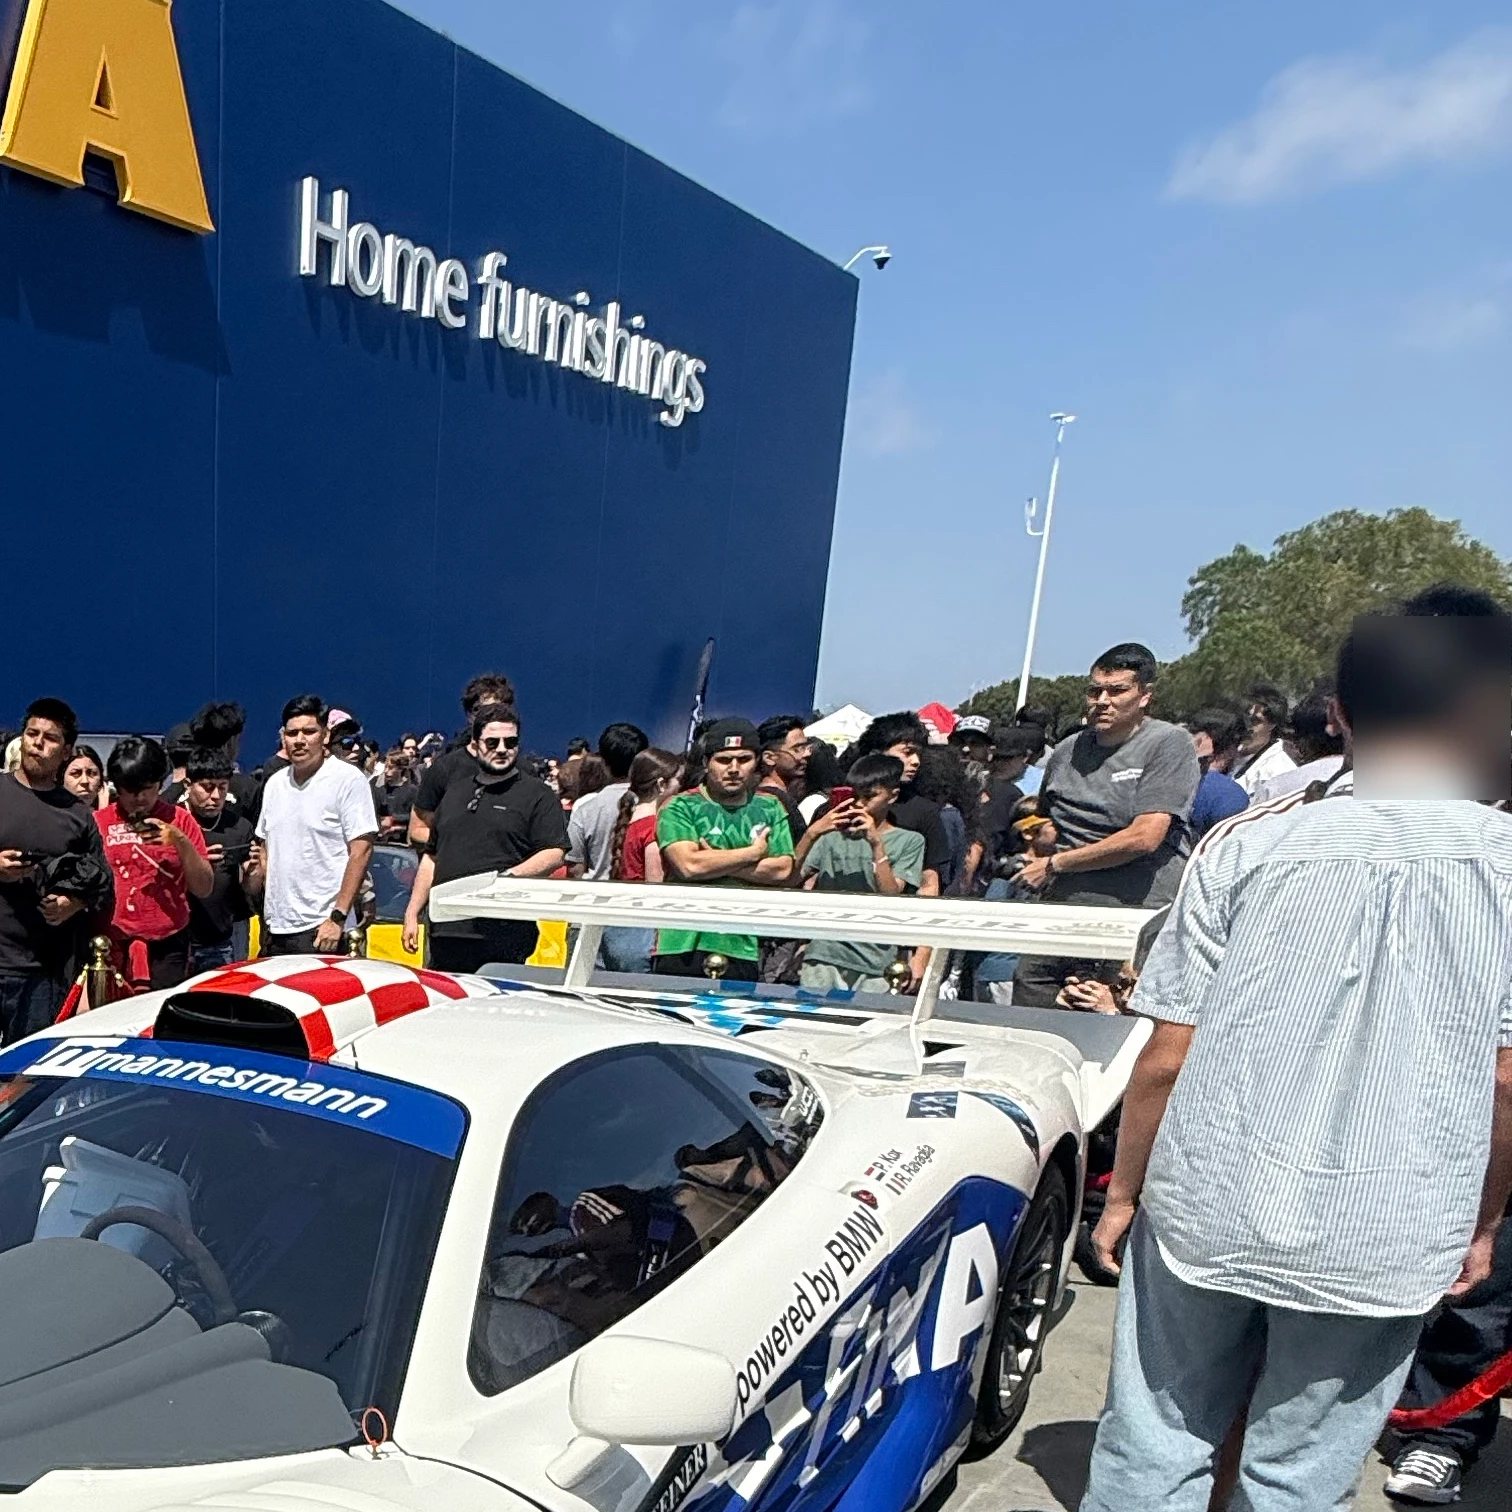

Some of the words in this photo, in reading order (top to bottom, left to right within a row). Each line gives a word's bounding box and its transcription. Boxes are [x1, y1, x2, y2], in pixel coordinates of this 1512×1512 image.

[297, 175, 470, 330] Home
[476, 250, 707, 428] furnishings
[90, 1048, 387, 1121] mannesmann
[735, 1281, 817, 1419] powered
[802, 1261, 840, 1303] by
[824, 1204, 884, 1277] BMW
